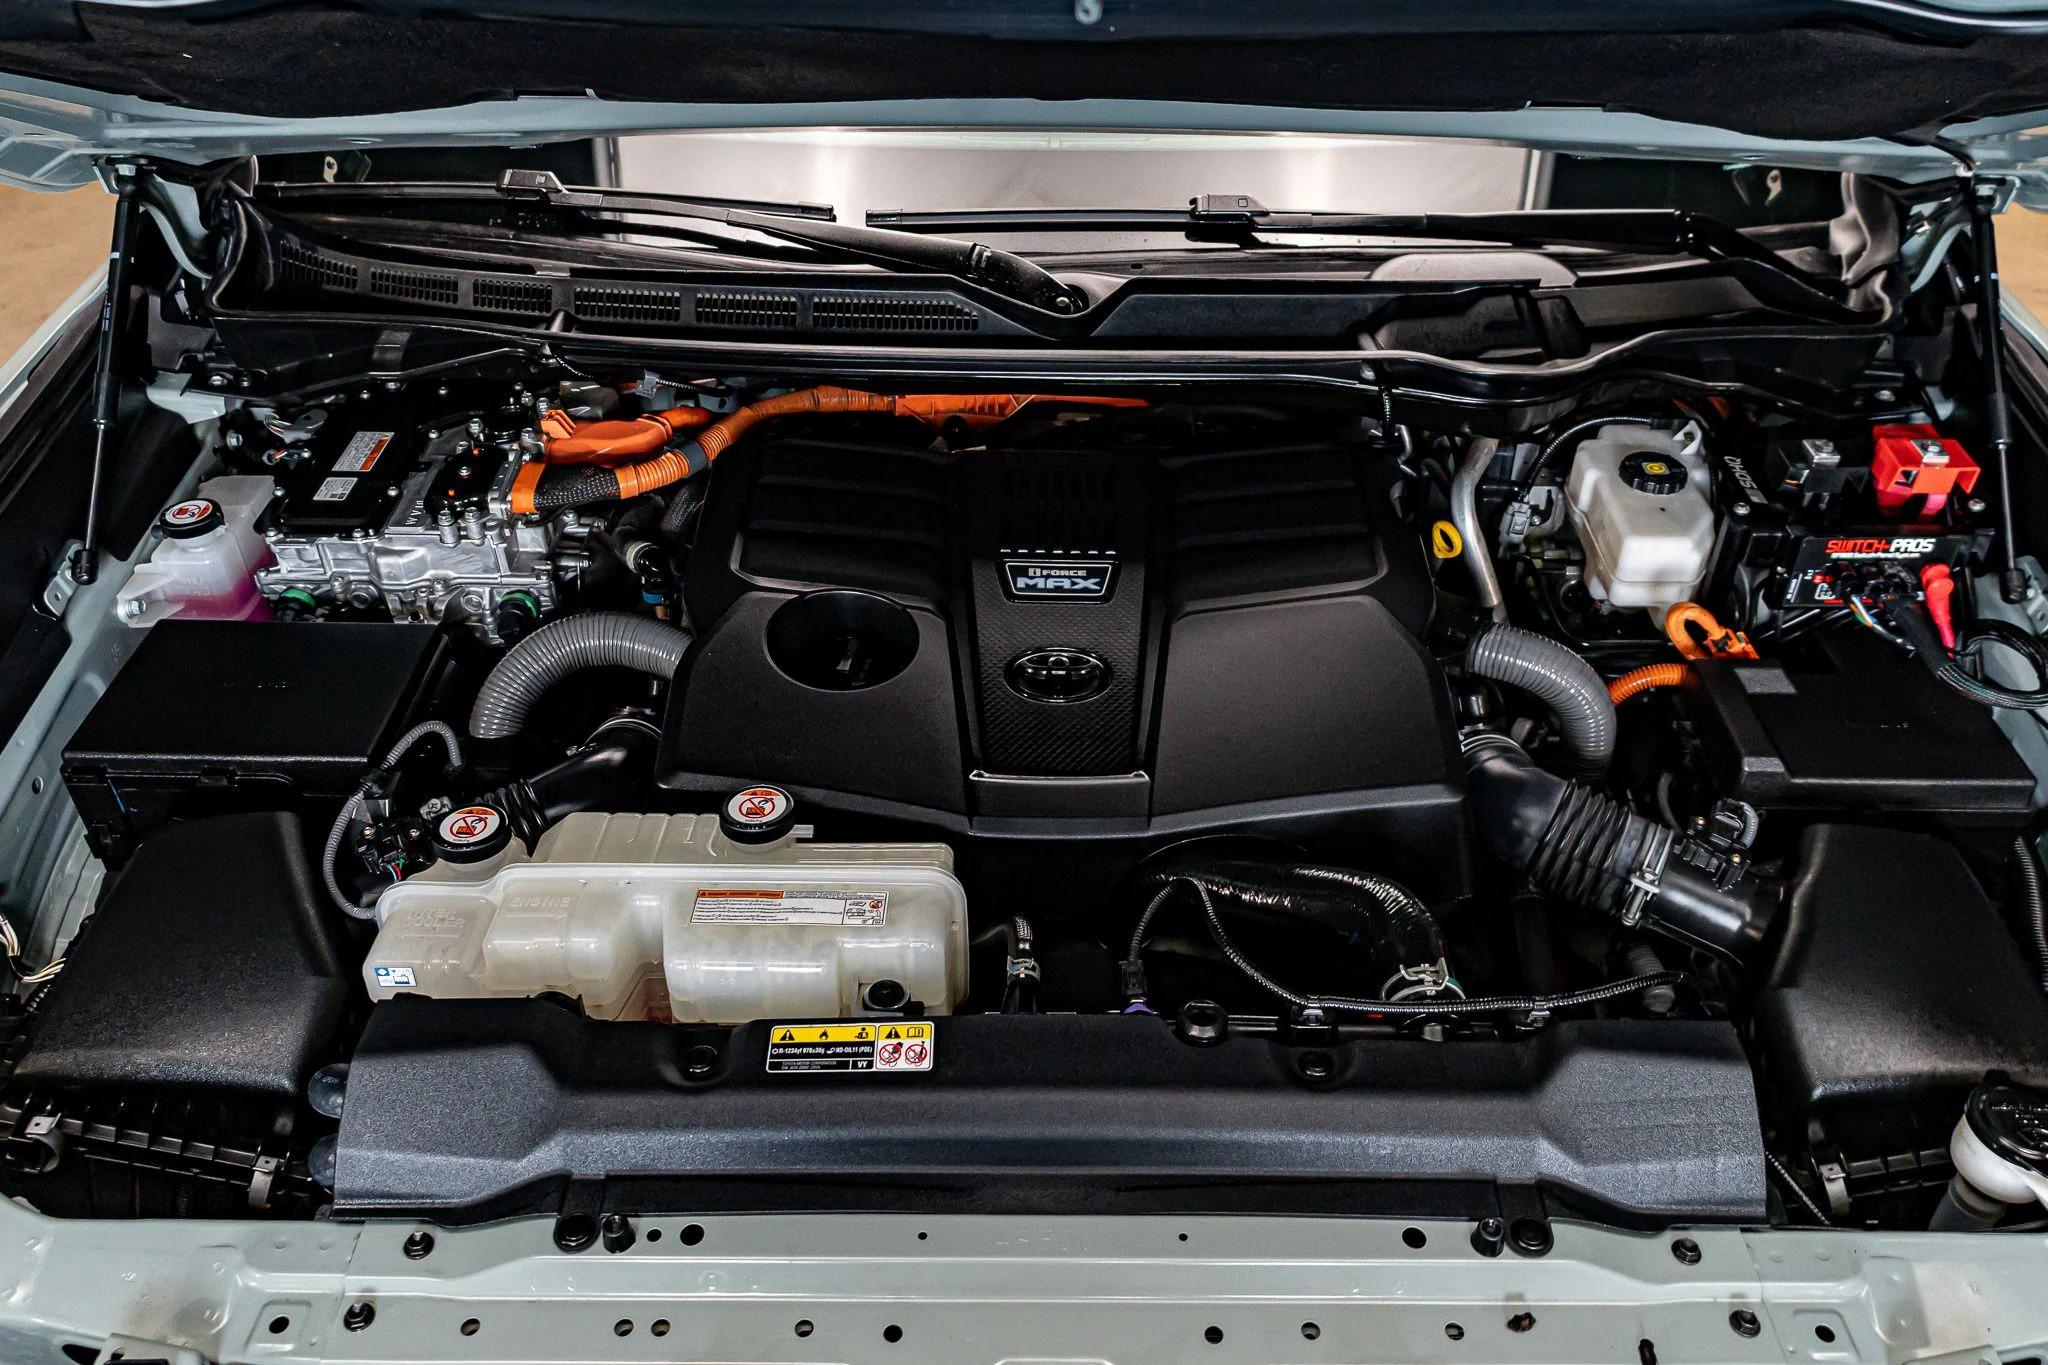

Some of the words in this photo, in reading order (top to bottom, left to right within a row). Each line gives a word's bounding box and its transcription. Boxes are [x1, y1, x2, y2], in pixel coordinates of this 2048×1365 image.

[1724, 456, 1757, 489] SDHQ
[1016, 577, 1101, 590] MAX
[509, 896, 571, 907] ENGINE
[778, 1047, 802, 1055] R-1234yf
[857, 1060, 868, 1069] VY
